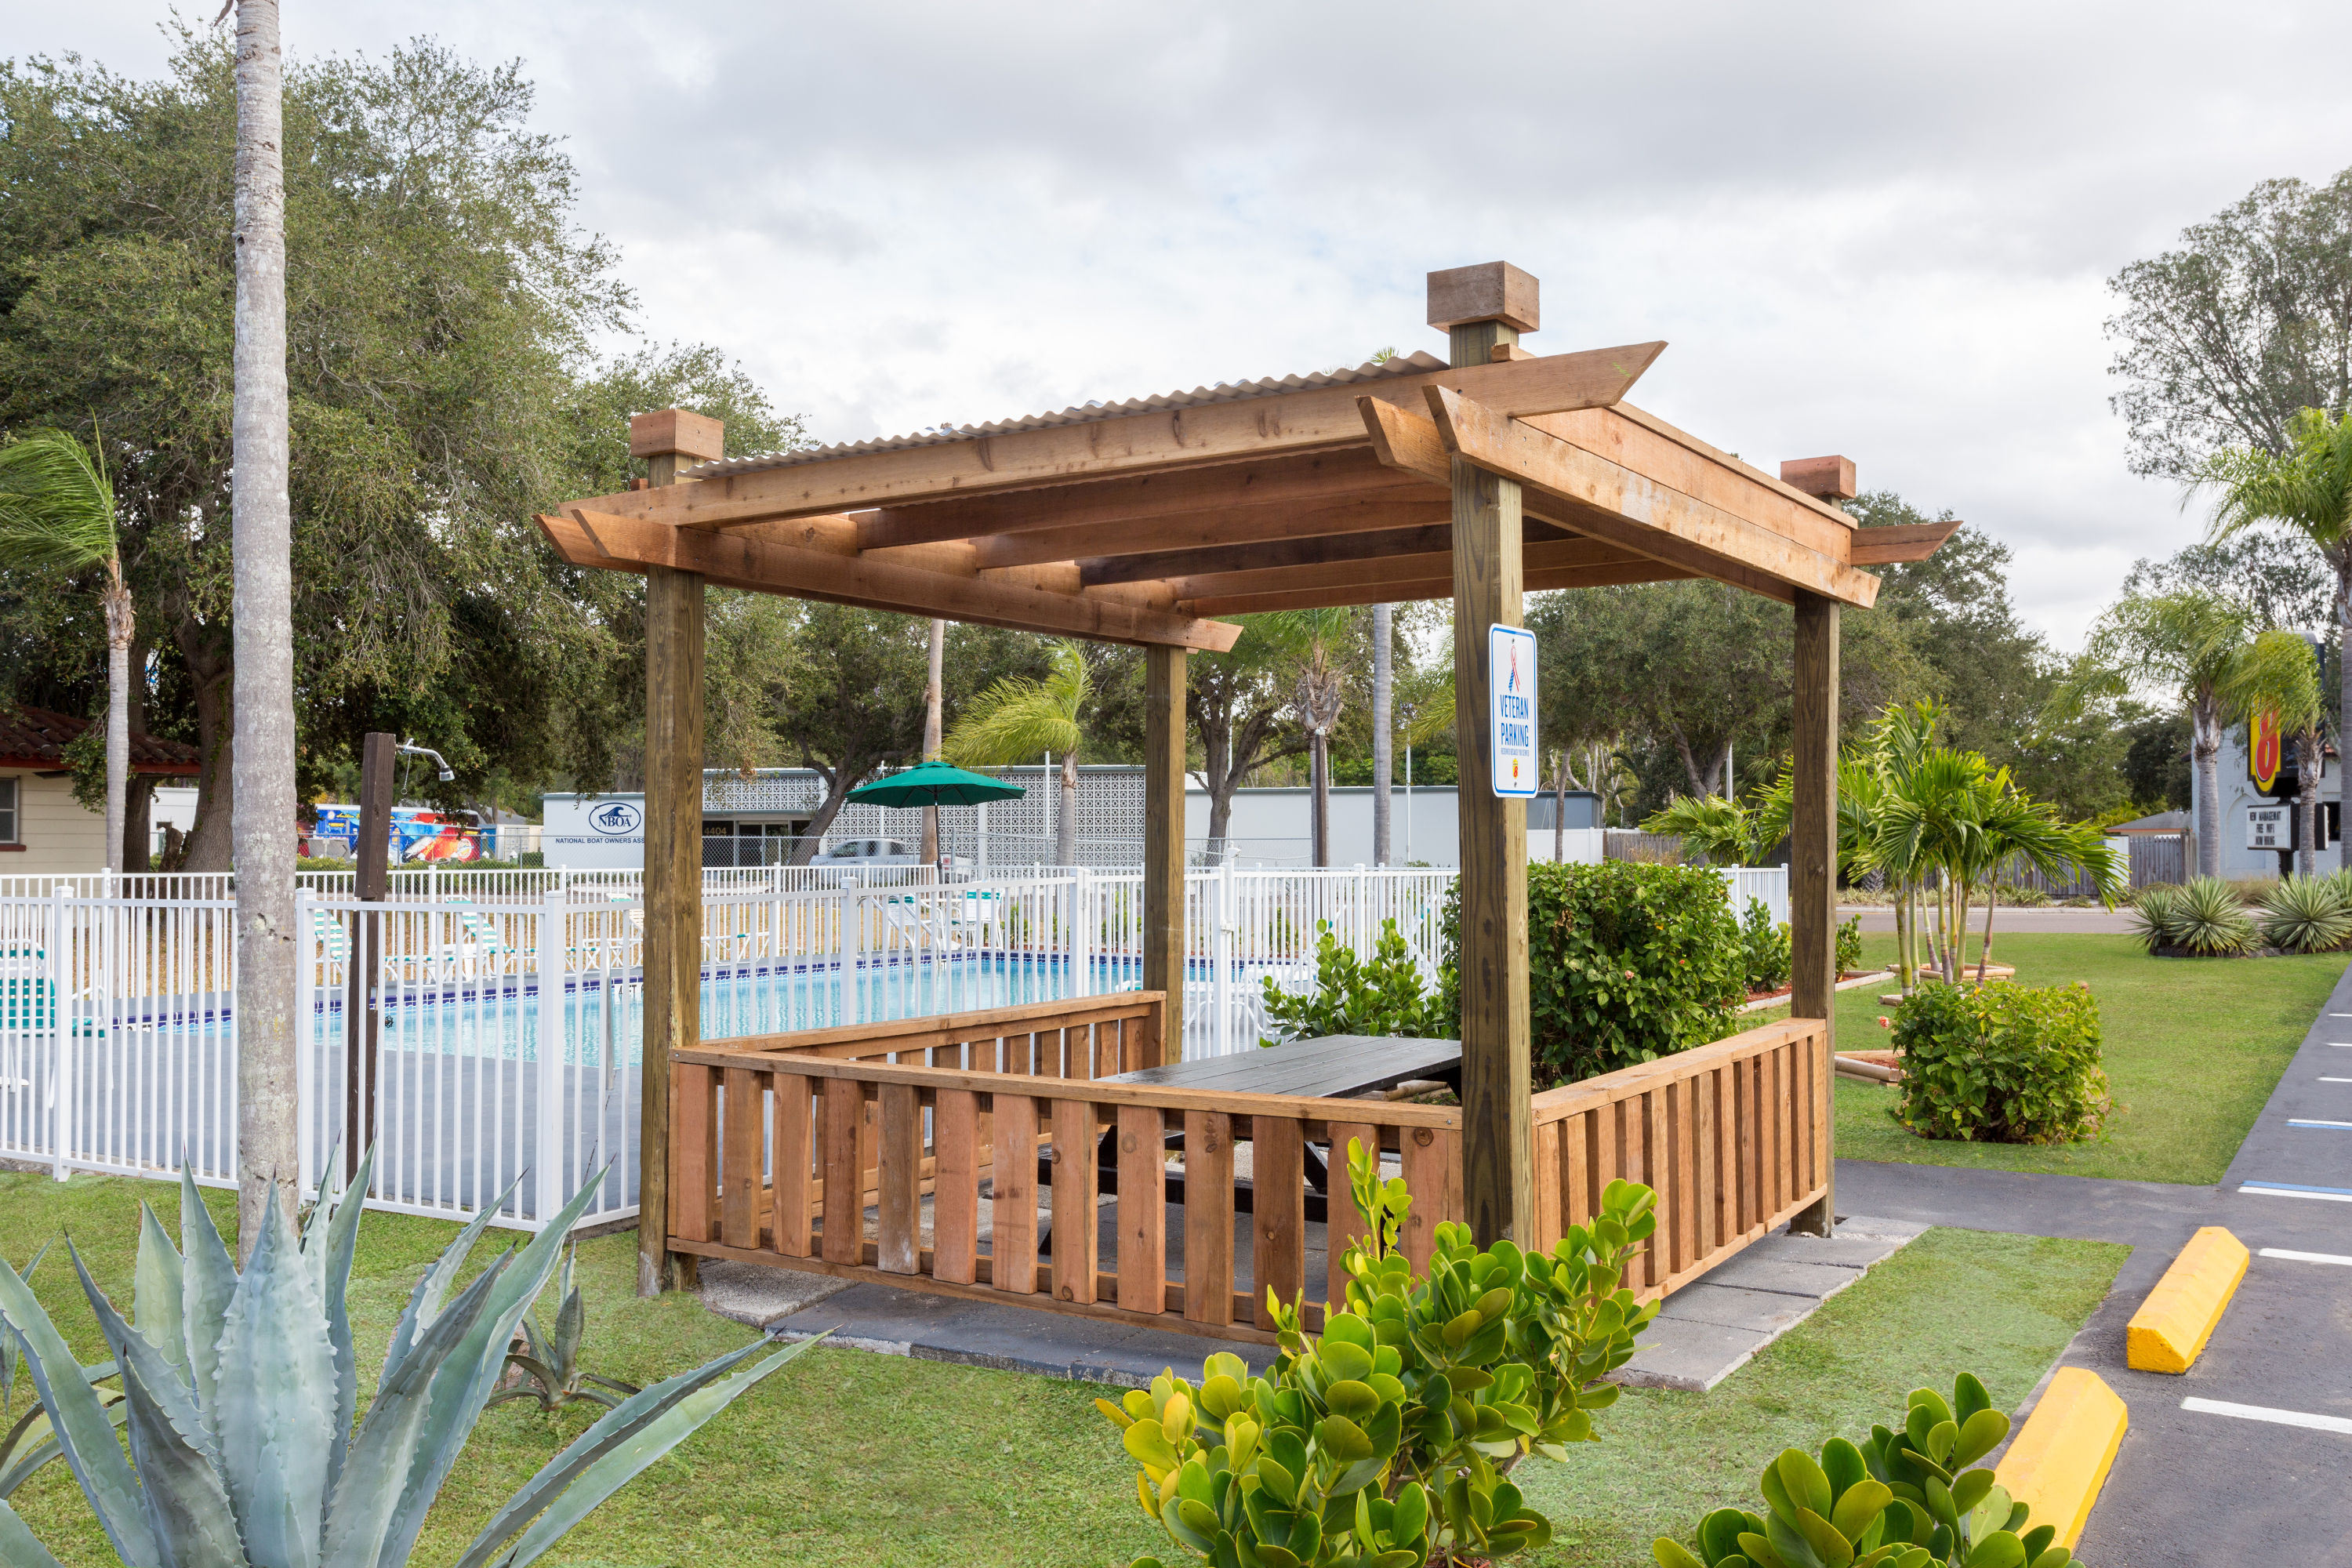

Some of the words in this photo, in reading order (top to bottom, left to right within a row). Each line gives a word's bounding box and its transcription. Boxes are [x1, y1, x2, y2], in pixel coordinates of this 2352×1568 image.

[1500, 695, 1529, 720] VETERAN
[1501, 722, 1529, 747] PARKING
[1513, 766, 1518, 778] 8
[598, 815, 631, 827] NBOA
